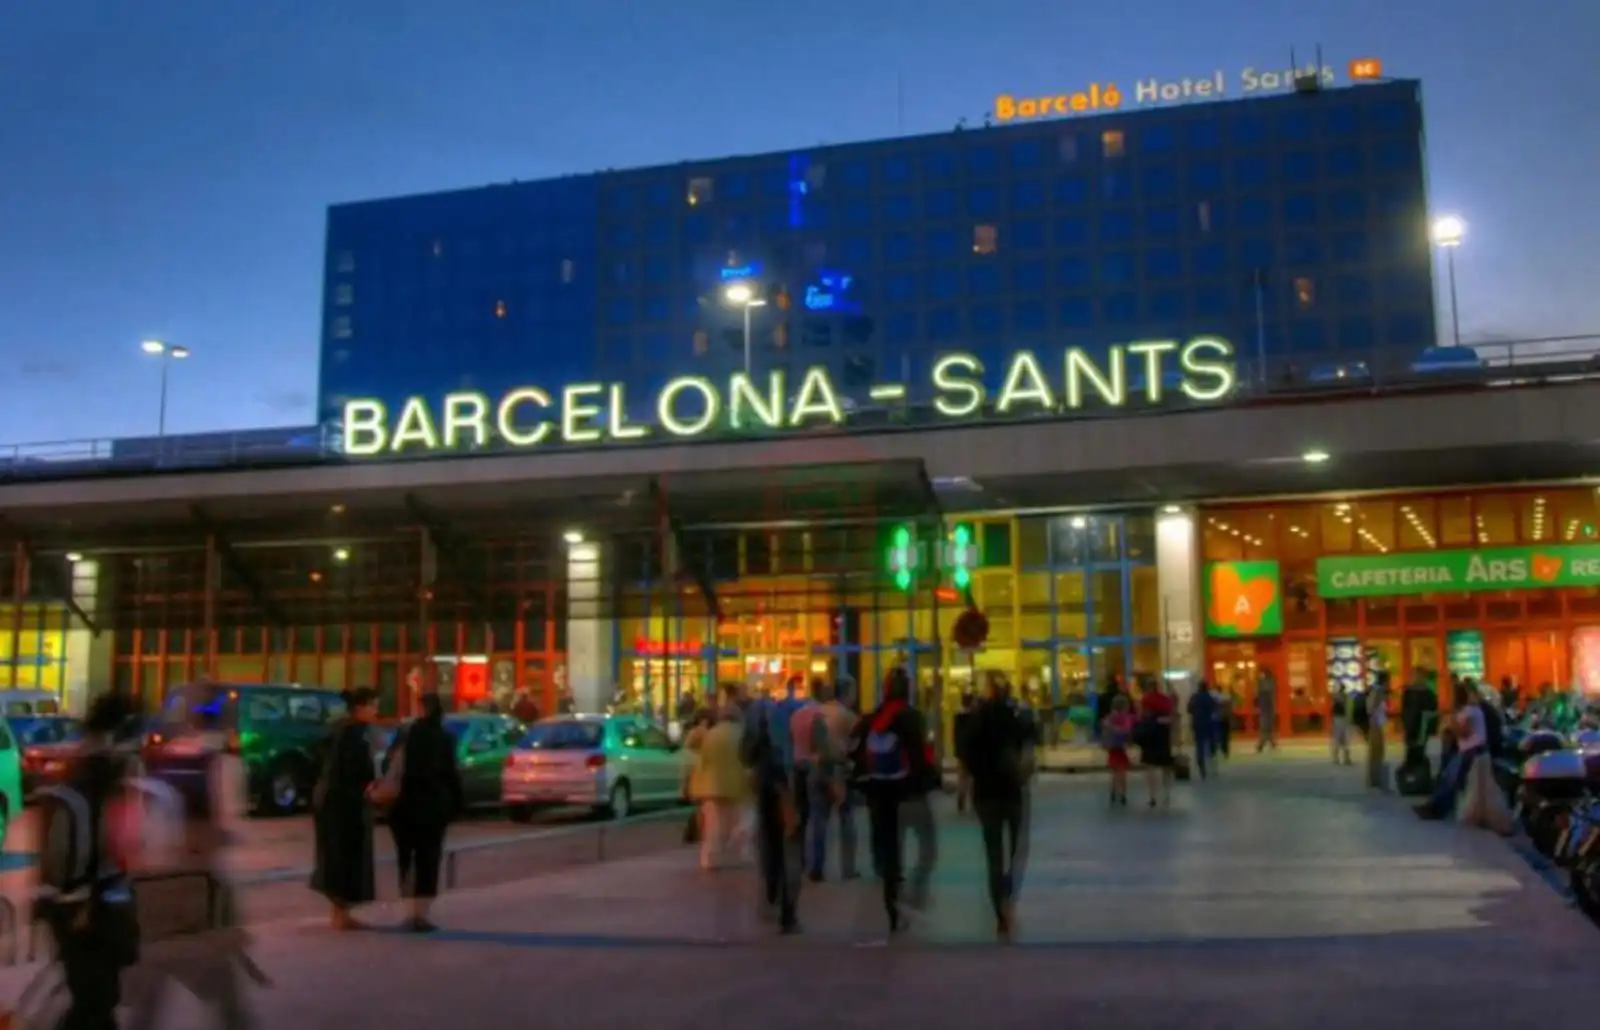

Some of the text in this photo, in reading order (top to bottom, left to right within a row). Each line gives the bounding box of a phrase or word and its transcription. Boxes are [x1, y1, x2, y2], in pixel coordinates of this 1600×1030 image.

[1136, 71, 1224, 102] Hotel
[343, 367, 843, 455] BARCELONA
[931, 335, 1236, 416] SANTS
[1331, 565, 1453, 589] CAFETERIA
[1233, 594, 1251, 615] A
